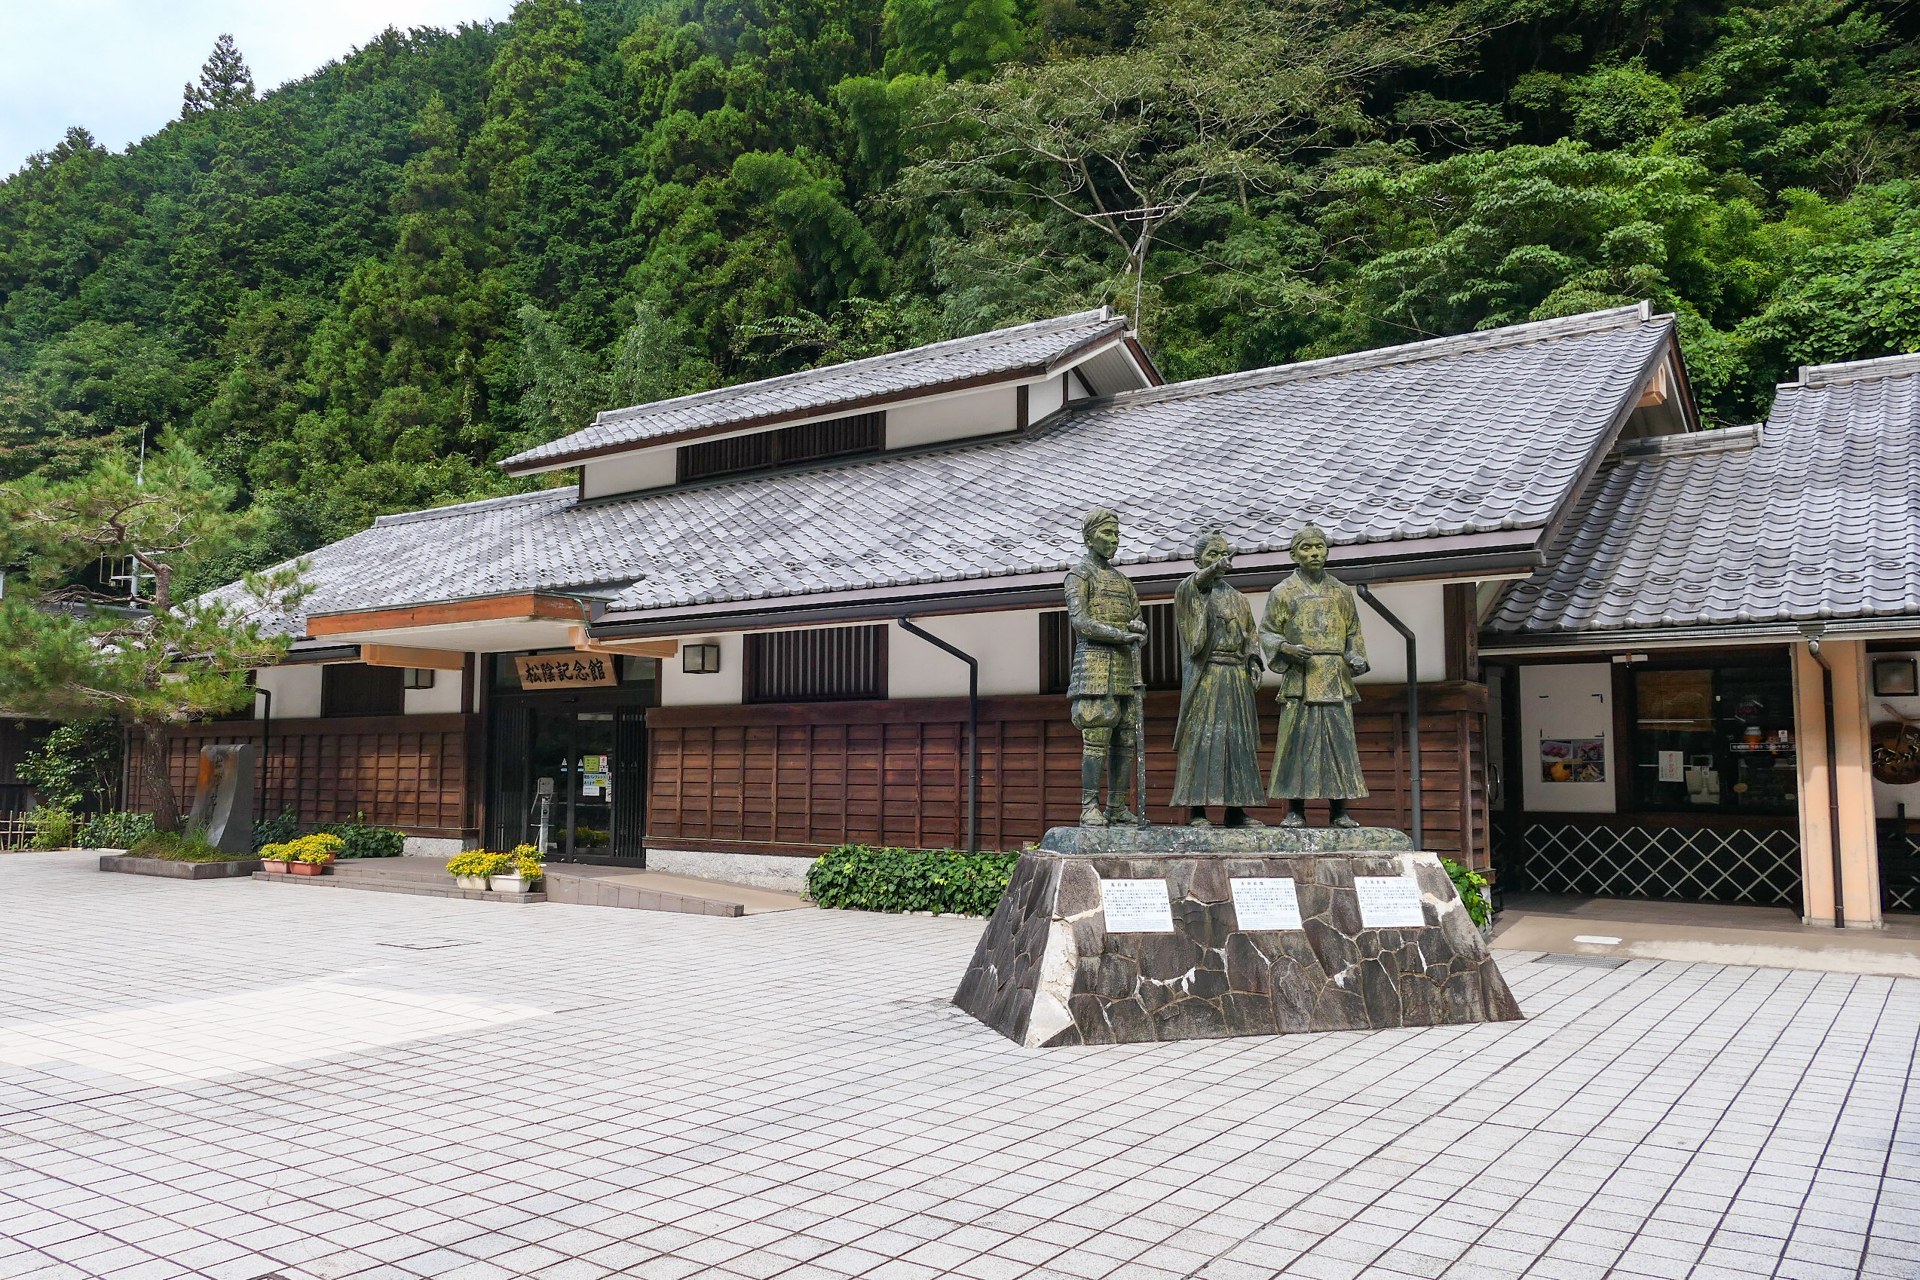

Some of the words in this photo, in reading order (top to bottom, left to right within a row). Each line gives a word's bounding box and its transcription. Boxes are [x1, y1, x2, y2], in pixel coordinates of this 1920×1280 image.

[525, 658, 606, 683] 松陰記念館
